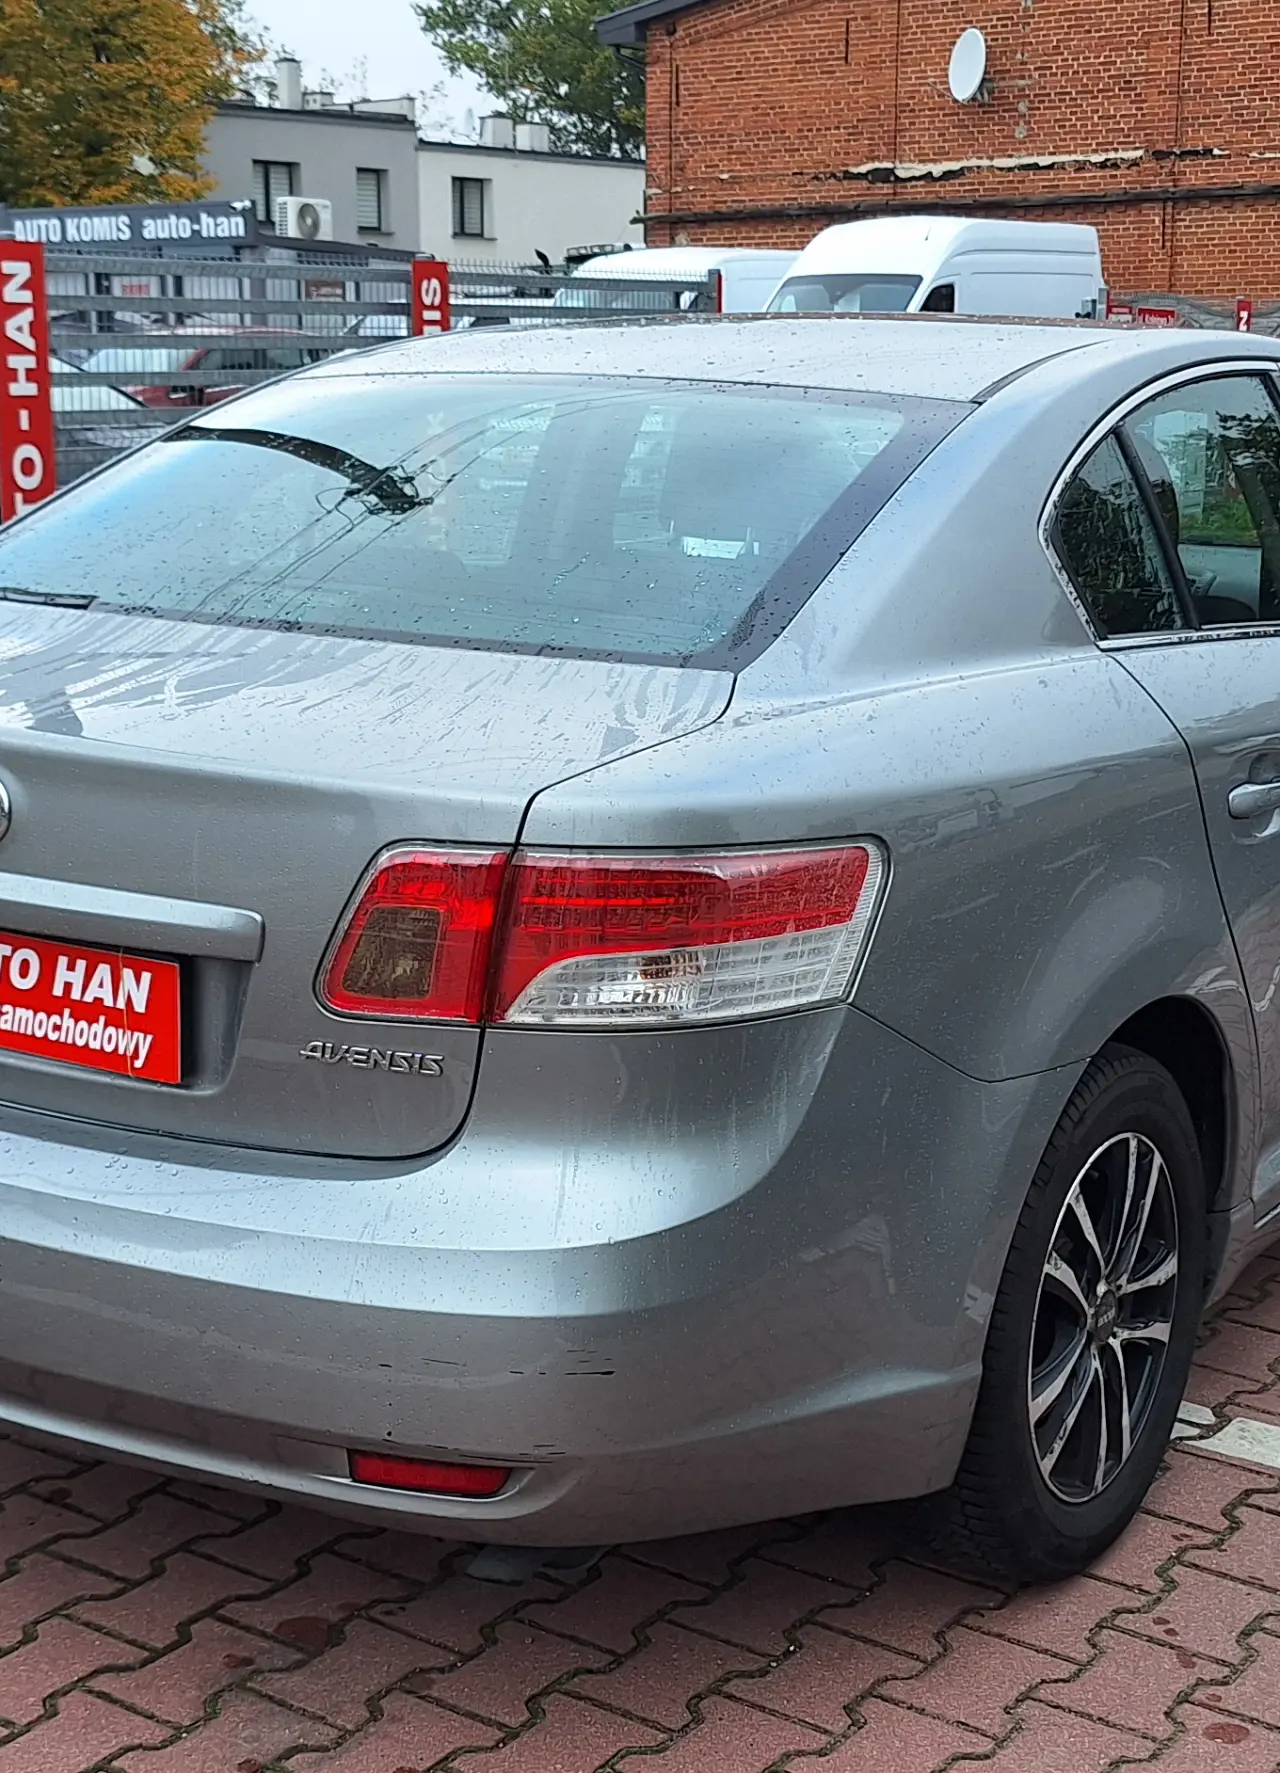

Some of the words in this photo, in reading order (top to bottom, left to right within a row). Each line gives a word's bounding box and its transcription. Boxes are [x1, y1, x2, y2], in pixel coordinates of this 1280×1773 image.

[13, 216, 61, 242] AUTO
[65, 214, 131, 241] KOMIS
[141, 212, 245, 240] auto-han
[52, 956, 152, 1014] HAN
[299, 1041, 444, 1076] AVENSIS
